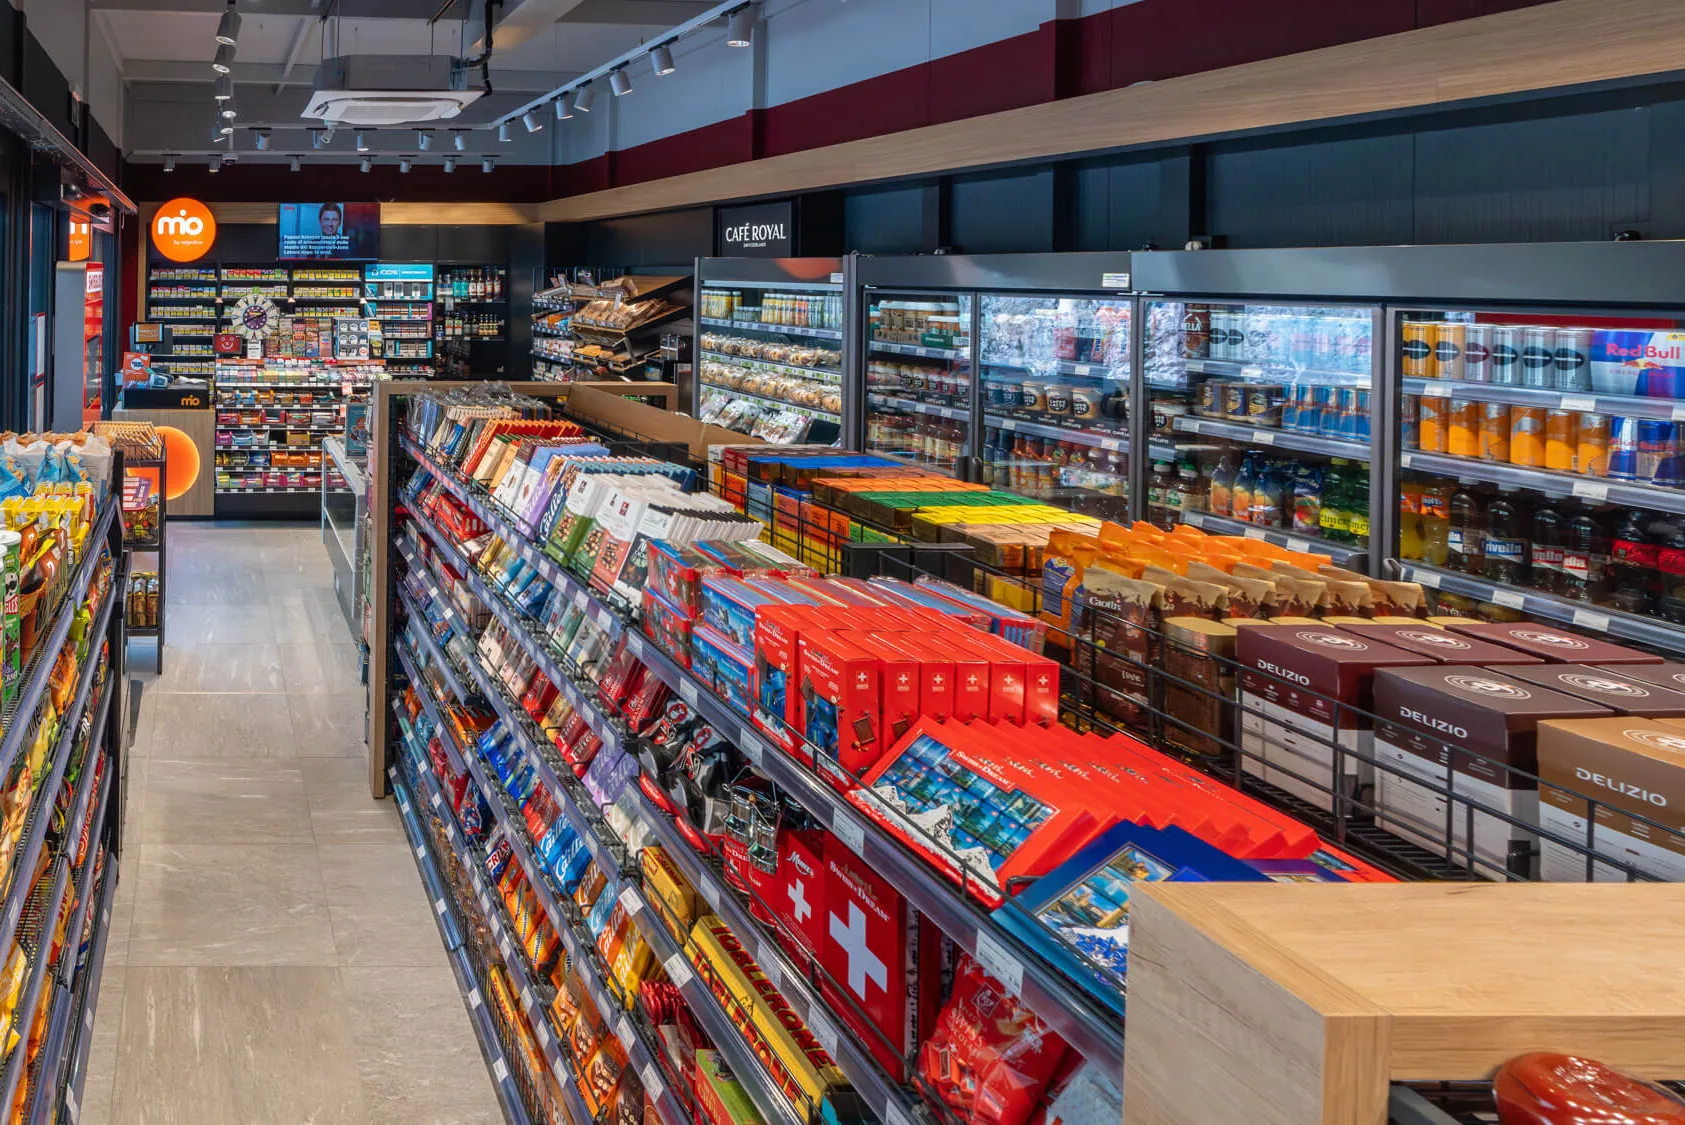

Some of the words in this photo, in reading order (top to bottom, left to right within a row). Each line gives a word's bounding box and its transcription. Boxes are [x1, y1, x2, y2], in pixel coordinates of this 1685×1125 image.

[158, 209, 203, 235] mio
[725, 222, 750, 242] CAFÉ
[751, 223, 787, 240] ROYAL
[1605, 343, 1642, 357] Red
[1645, 345, 1681, 359] Bull
[180, 394, 200, 407] mio
[1257, 659, 1311, 687] DELIZIO
[1400, 706, 1468, 739] DELIZIO
[1575, 766, 1668, 808] DELIZIO
[711, 925, 837, 1071] TOBLERONE
